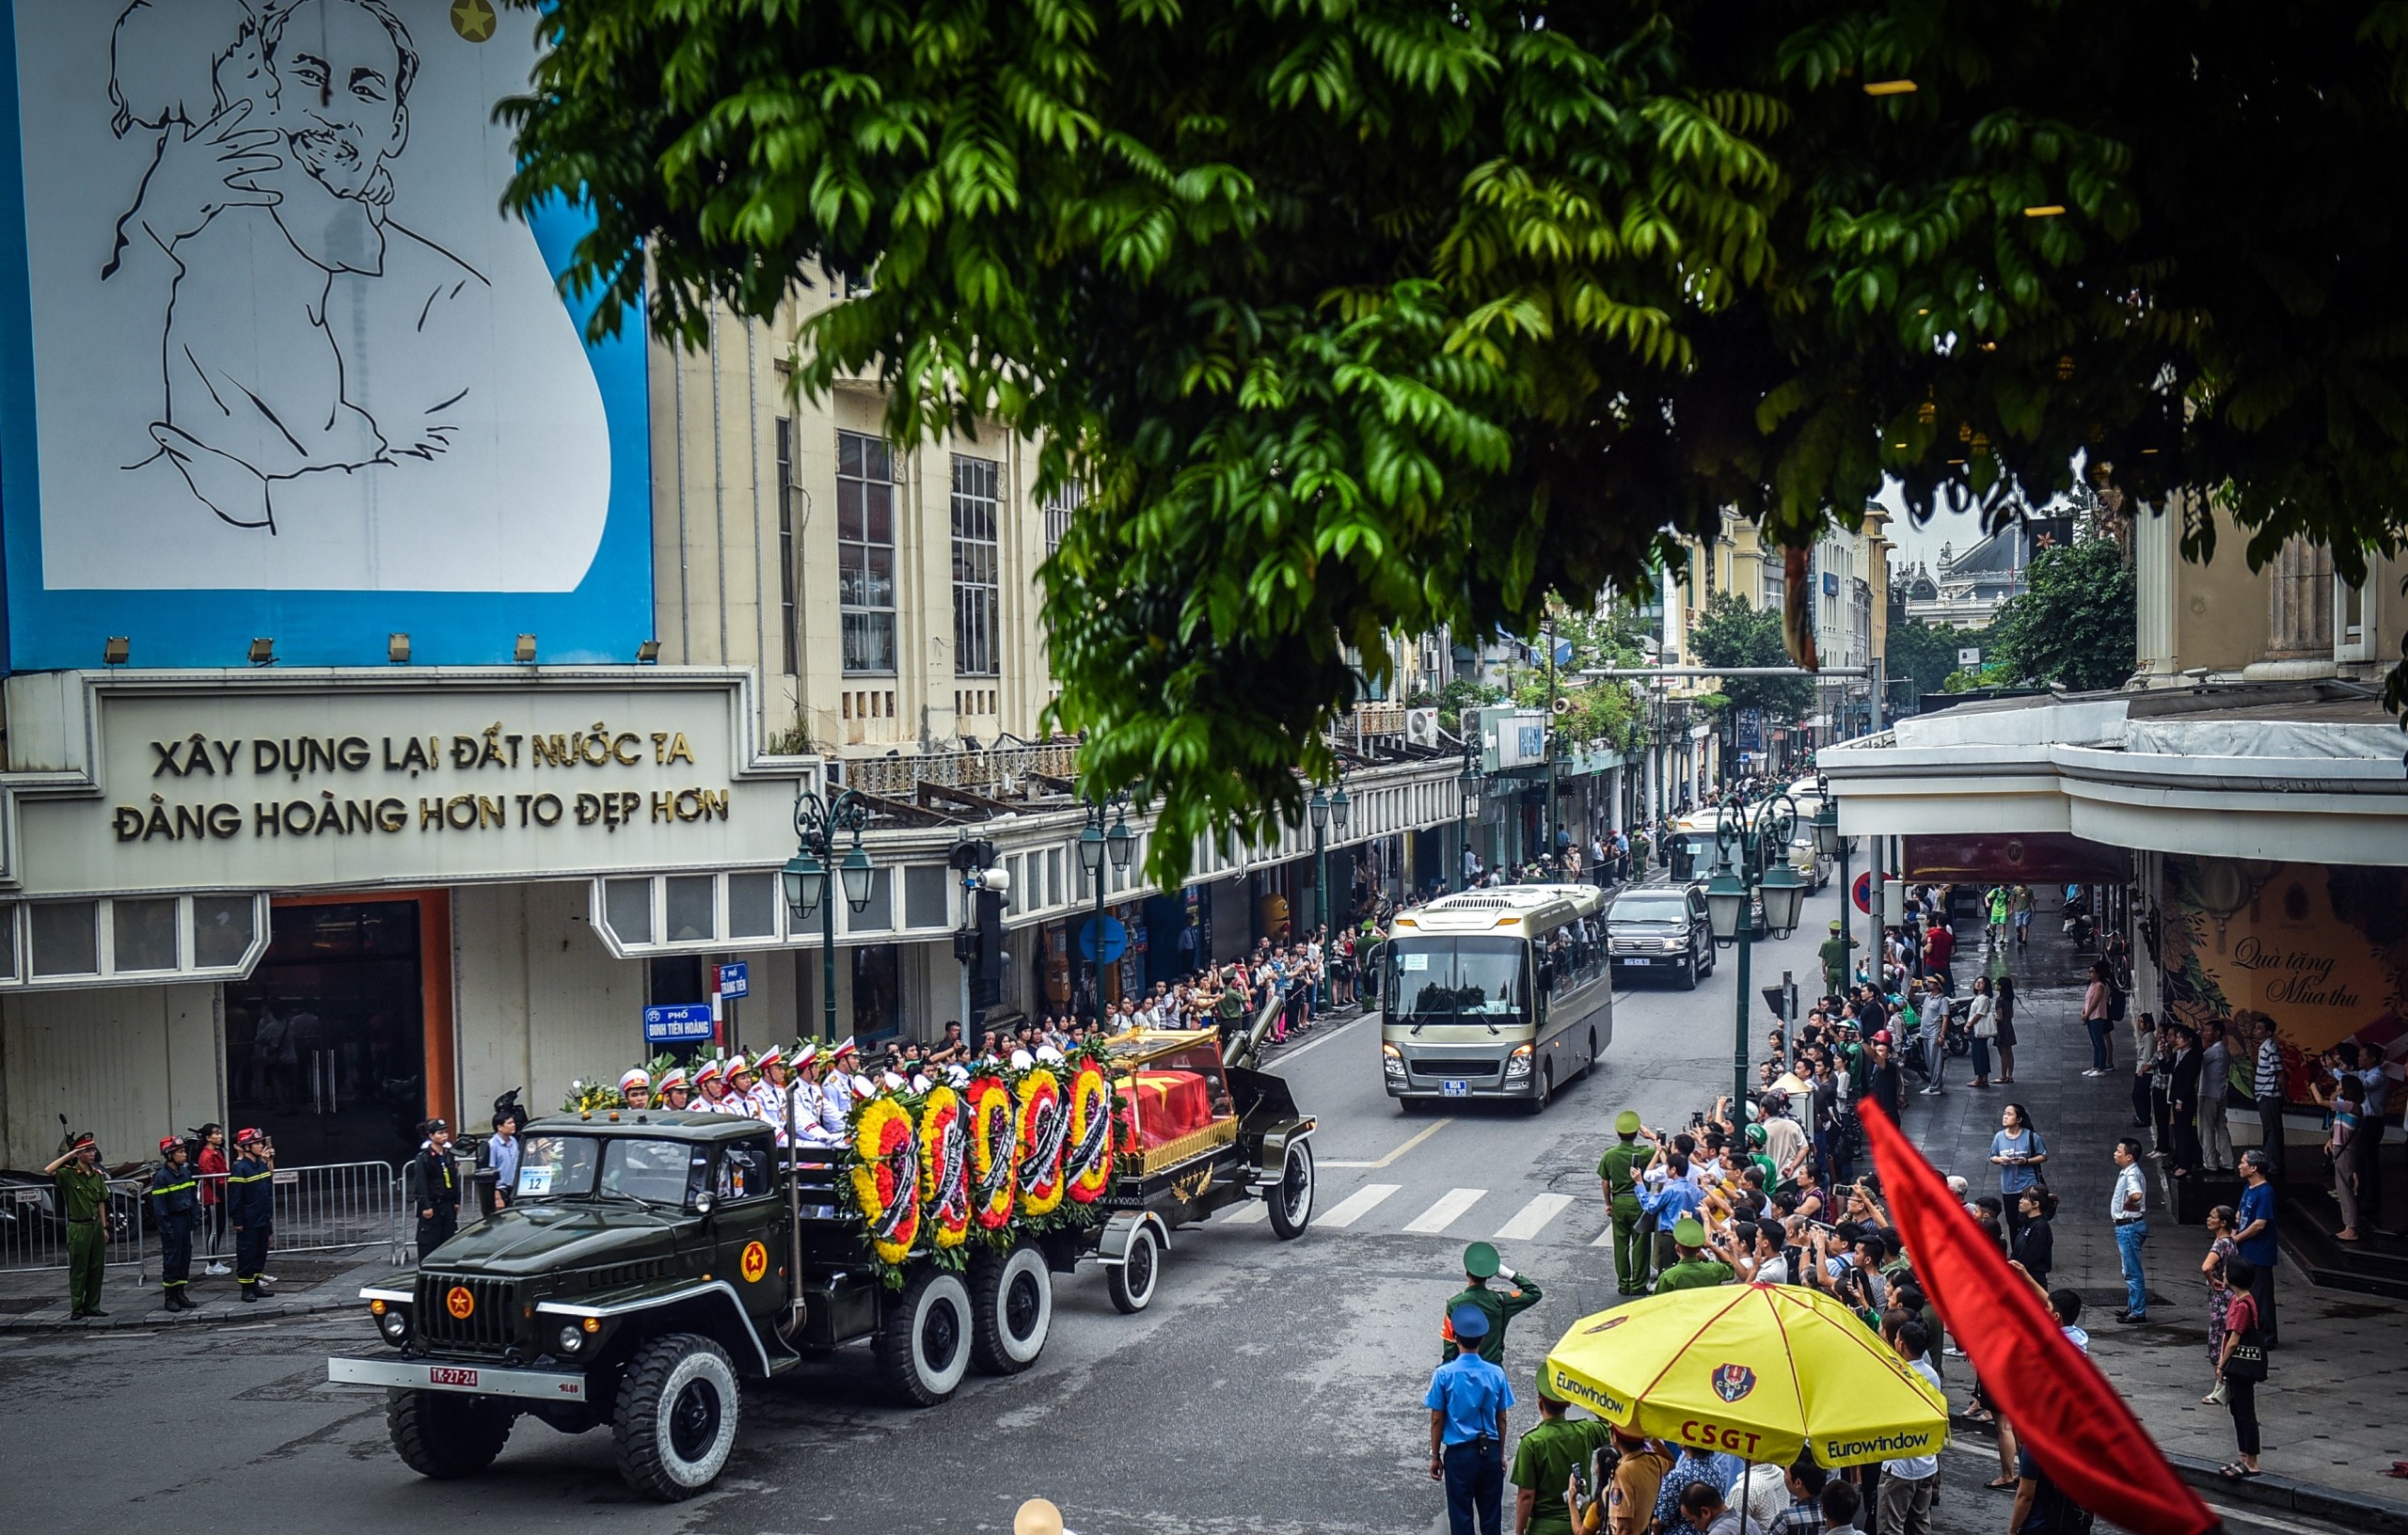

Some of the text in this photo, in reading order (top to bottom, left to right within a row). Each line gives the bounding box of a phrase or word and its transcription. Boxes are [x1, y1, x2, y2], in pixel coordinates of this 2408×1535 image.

[150, 721, 695, 782] XÂY DỰNG LẠI ĐẤT NƯỚC TA
[113, 787, 729, 842] ĐÀNG HOÀNG HƠN TO ĐẸP HƠN
[2231, 936, 2335, 986] Quà tặng
[2266, 974, 2360, 1008] Mùa thu
[667, 1008, 689, 1020] PHỐ
[684, 1019, 709, 1035] HOÀNG
[529, 1178, 542, 1190] 12
[1557, 1370, 1624, 1416] Eurowindow
[1716, 1380, 1749, 1391] CSGT
[1681, 1420, 1762, 1454] CSGT
[1828, 1432, 1929, 1459] Eurowindow
